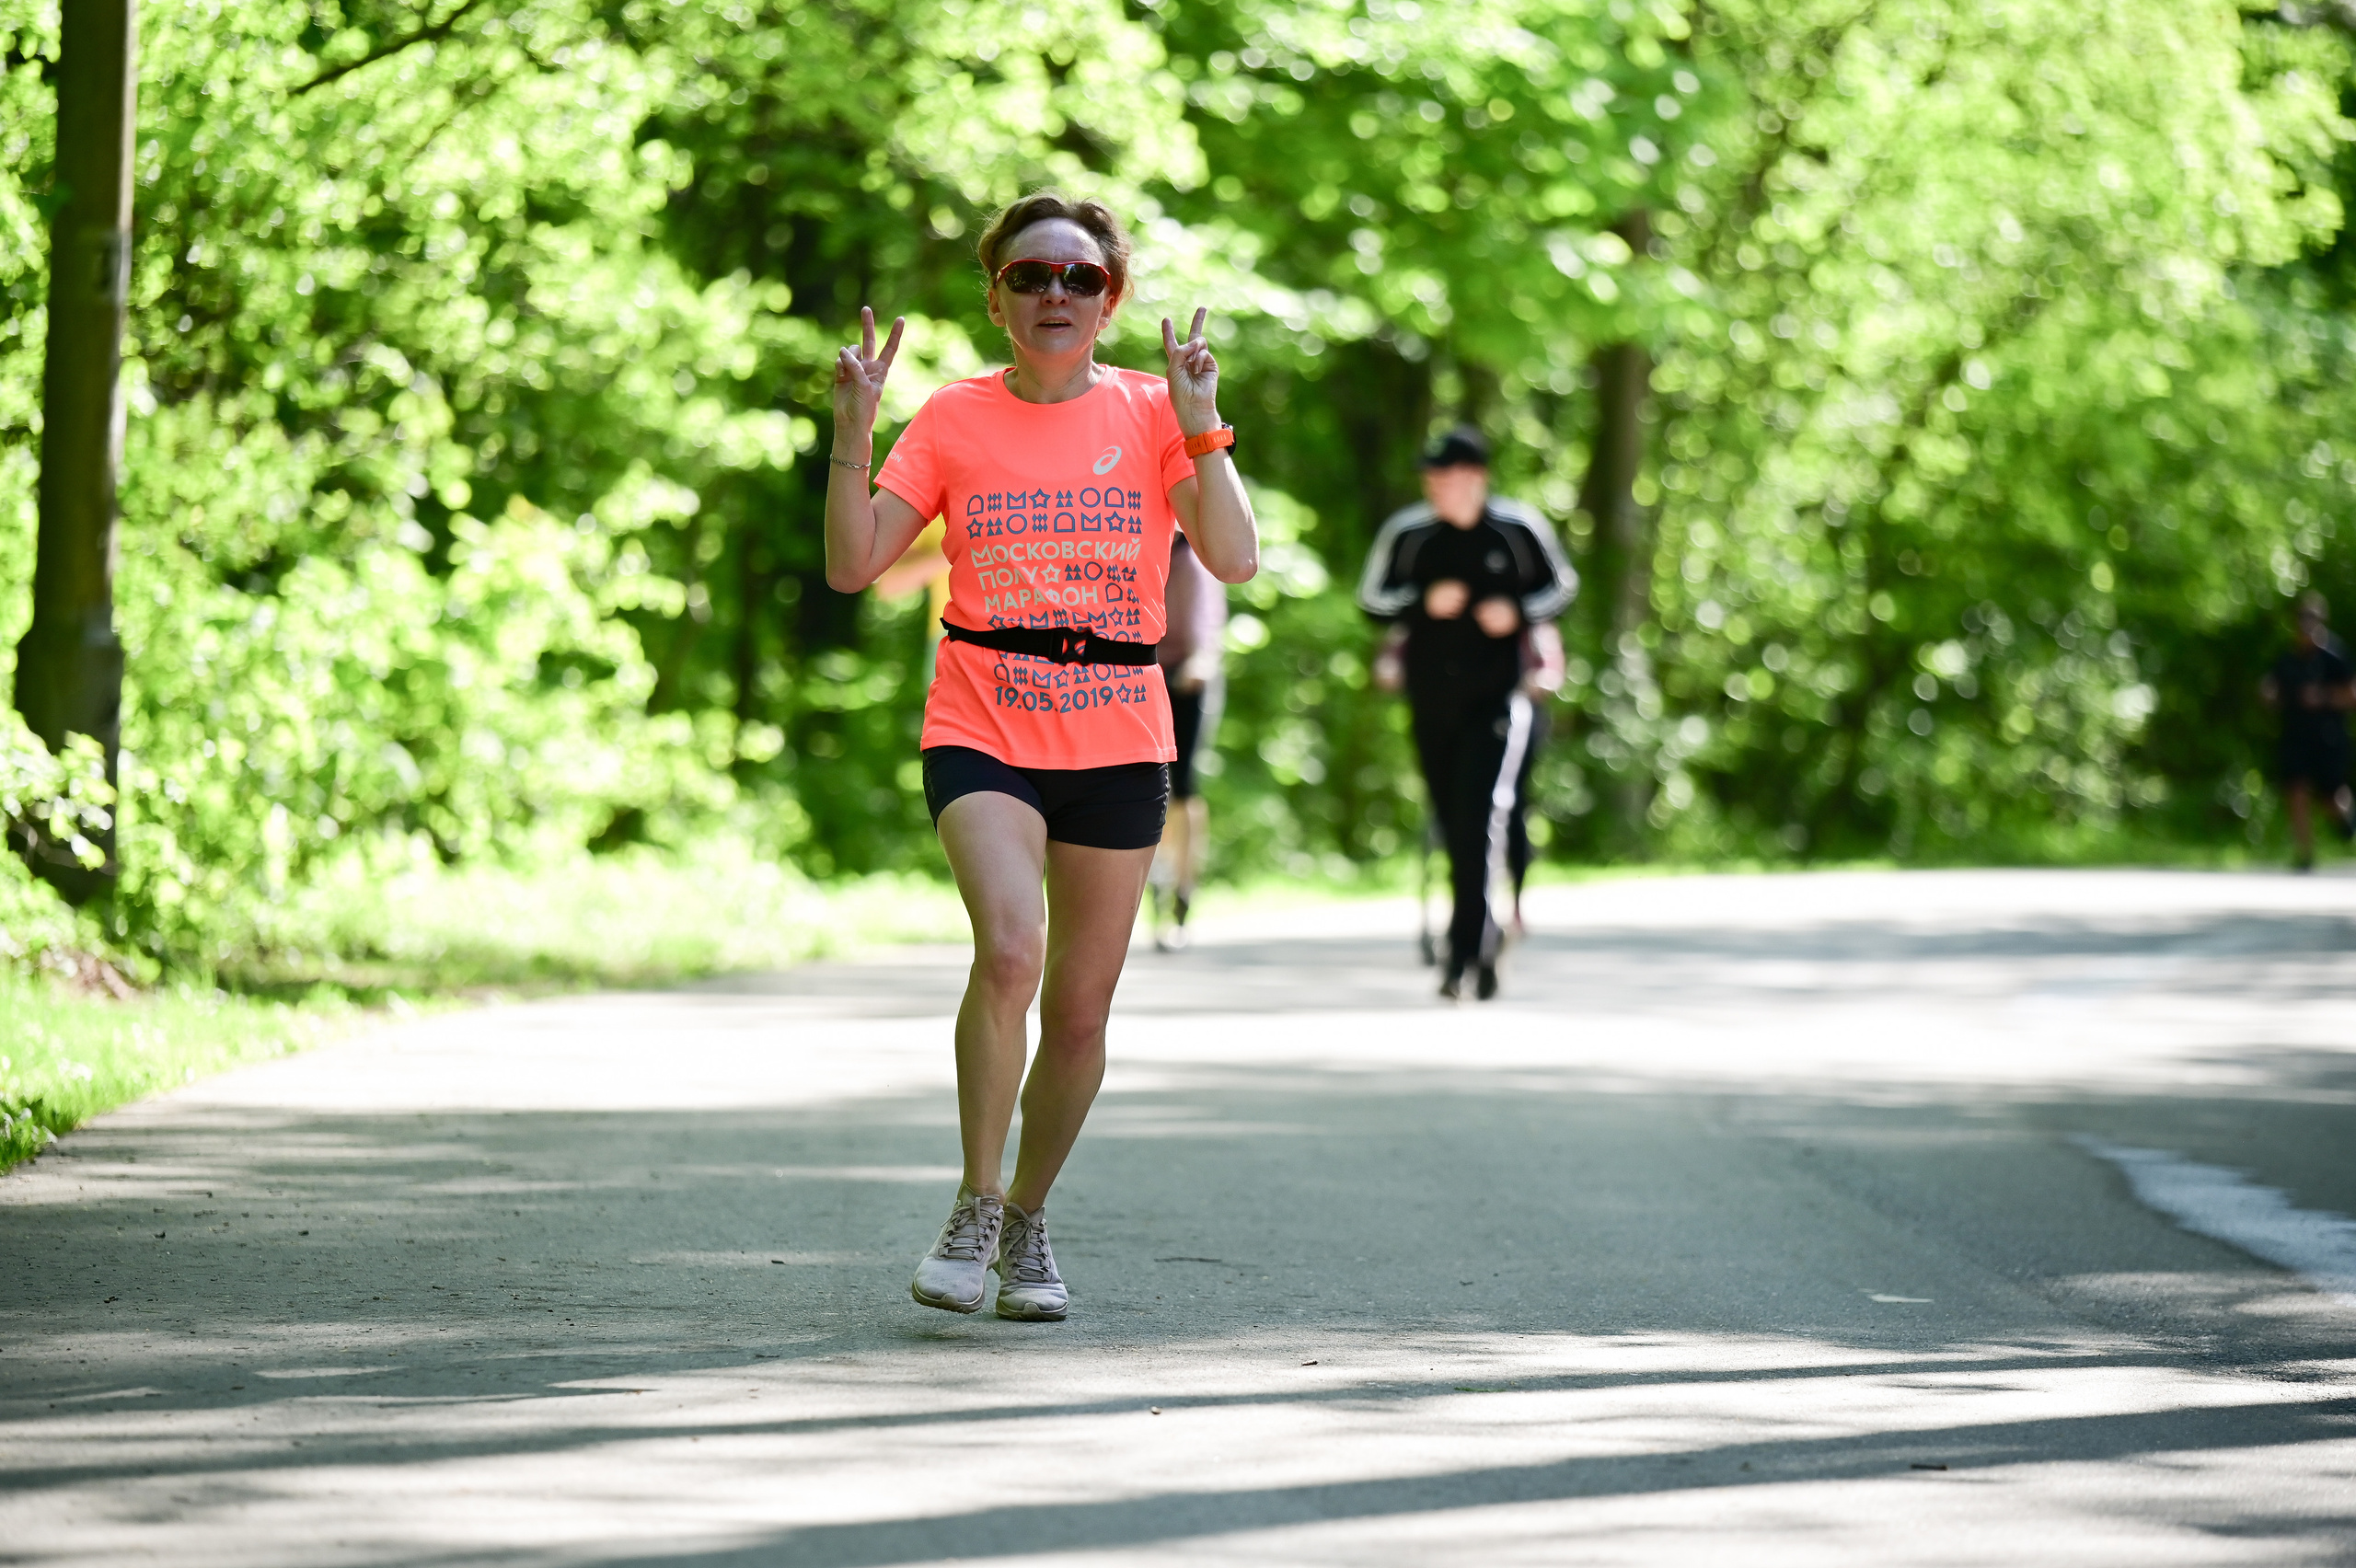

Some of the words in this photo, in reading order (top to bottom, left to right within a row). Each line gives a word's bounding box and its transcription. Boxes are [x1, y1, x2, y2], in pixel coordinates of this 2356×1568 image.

[970, 537, 1141, 568] МОСКОВСКИЙ
[977, 566, 1039, 591] ПОЛУ
[985, 585, 1098, 613] МАРАФОН
[995, 686, 1114, 713] 19.05.2019
